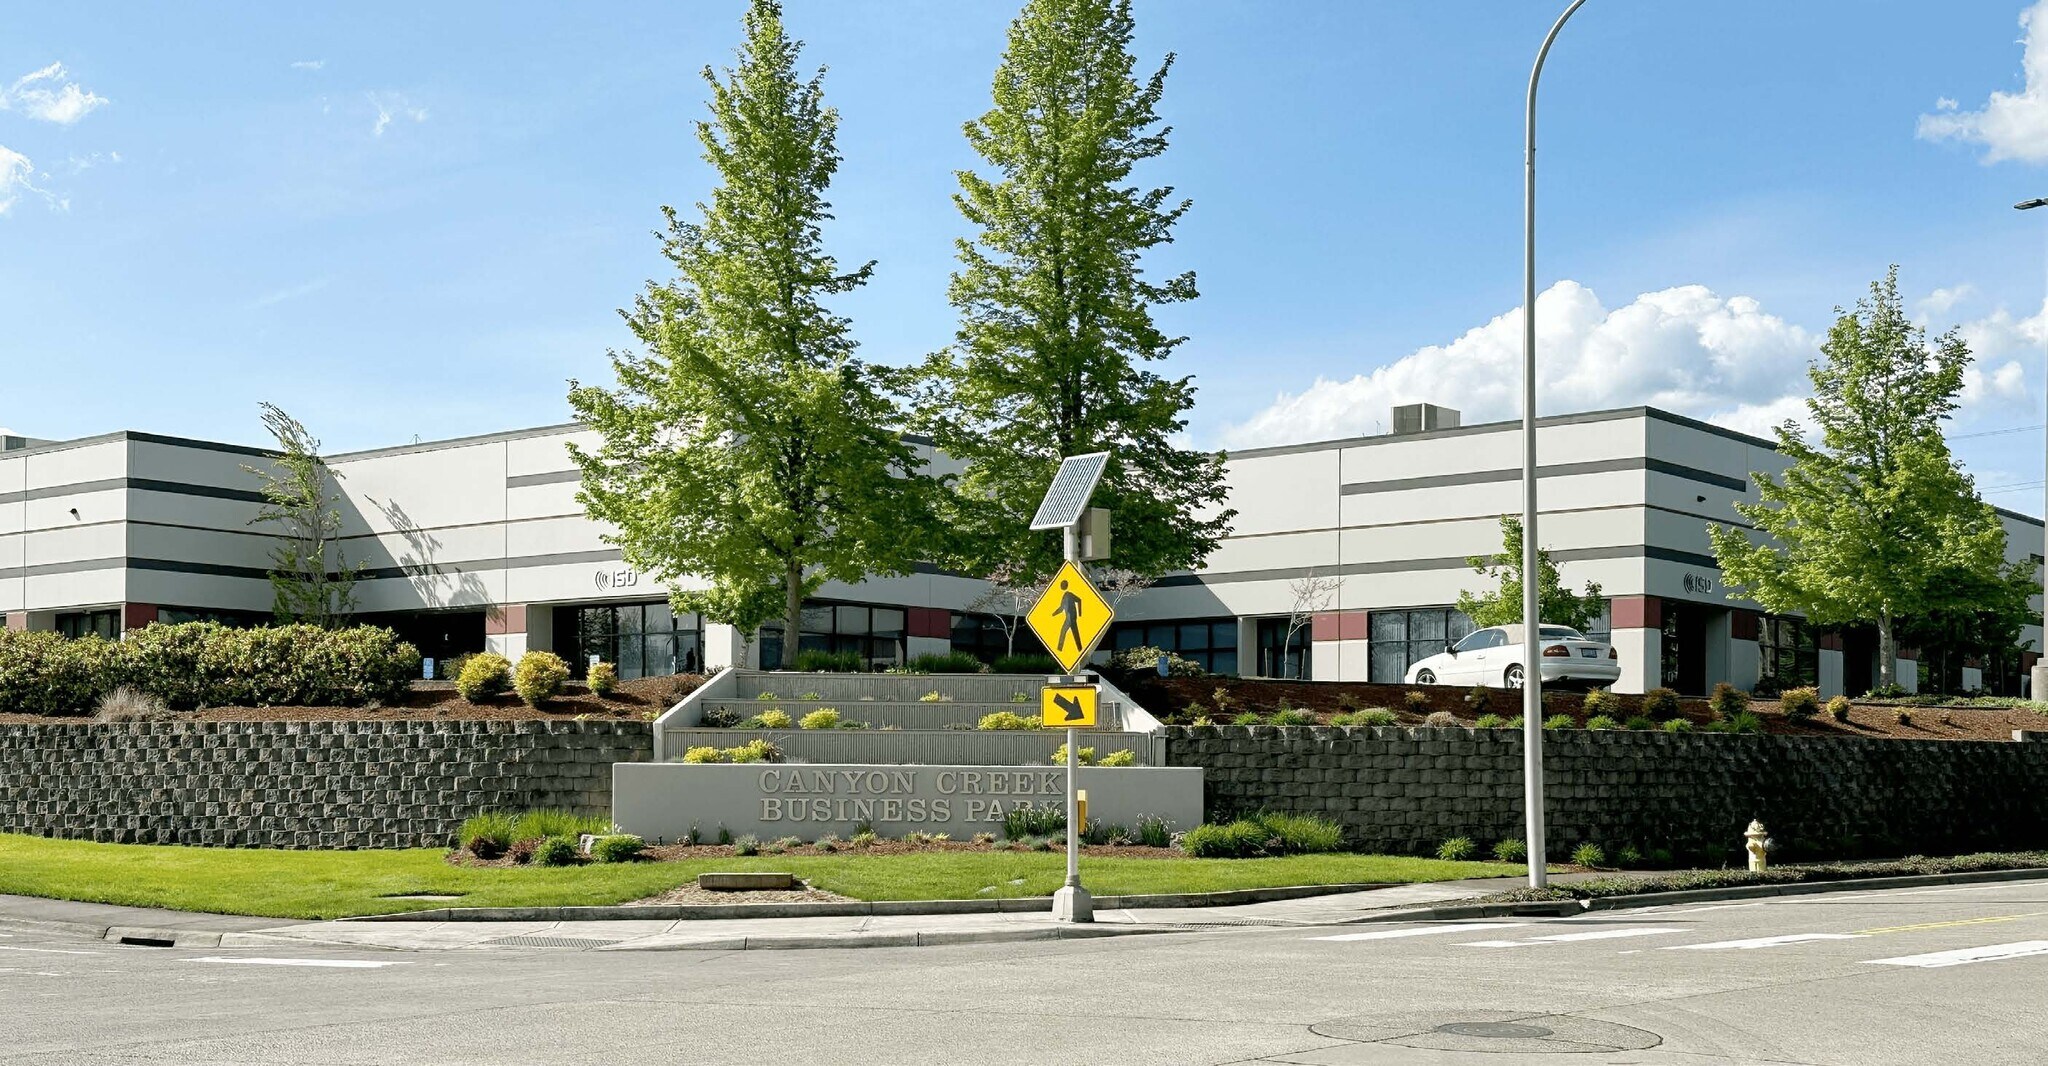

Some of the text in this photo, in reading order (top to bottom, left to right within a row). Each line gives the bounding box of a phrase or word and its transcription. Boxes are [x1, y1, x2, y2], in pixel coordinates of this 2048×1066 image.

[612, 569, 638, 588] ISD
[1694, 575, 1713, 594] ISD
[758, 769, 1064, 796] CANYON CREEK
[758, 797, 951, 823] BUSINESS
